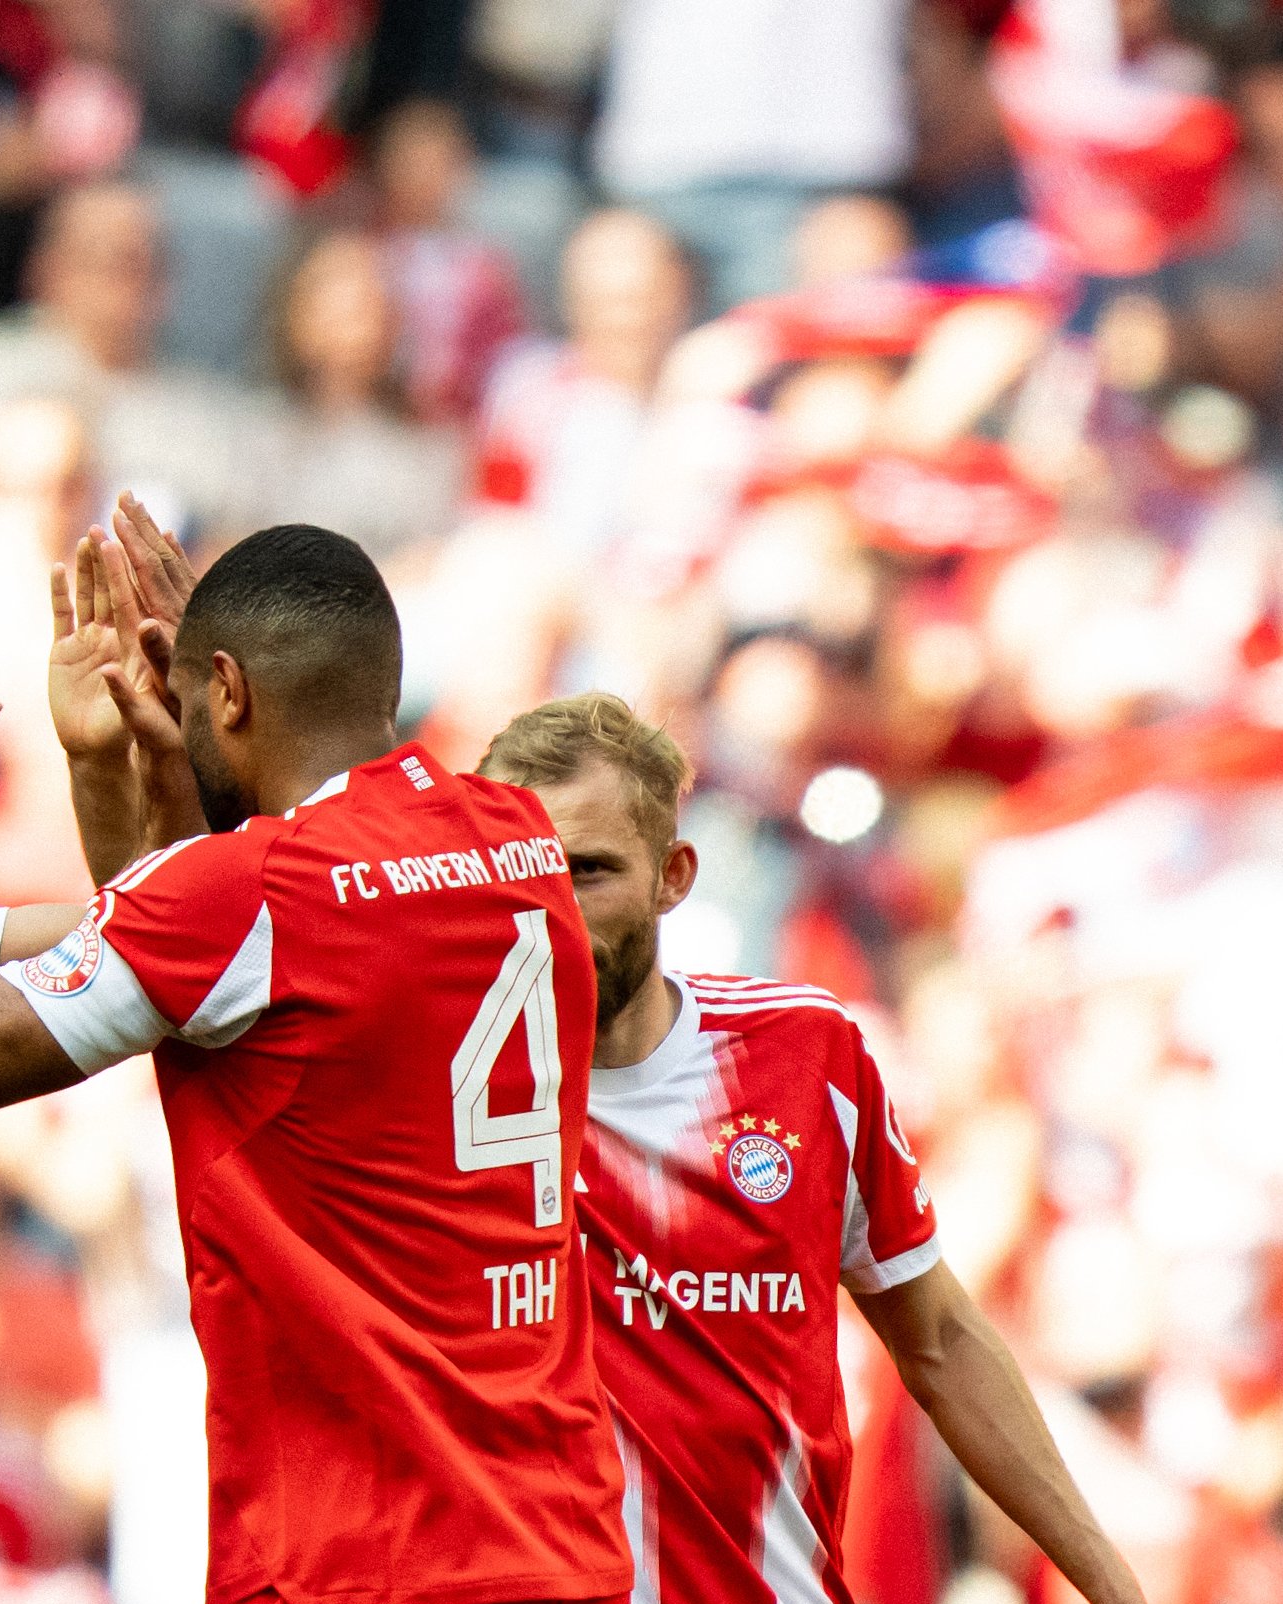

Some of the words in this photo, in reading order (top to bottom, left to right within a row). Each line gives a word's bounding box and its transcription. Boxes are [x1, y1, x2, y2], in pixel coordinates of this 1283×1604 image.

[330, 861, 380, 904] FC
[380, 849, 492, 895] BAYERN
[450, 908, 563, 1228] 4
[740, 1139, 784, 1163] BAYERN
[484, 1258, 557, 1329] TAH
[613, 1286, 669, 1330] TV
